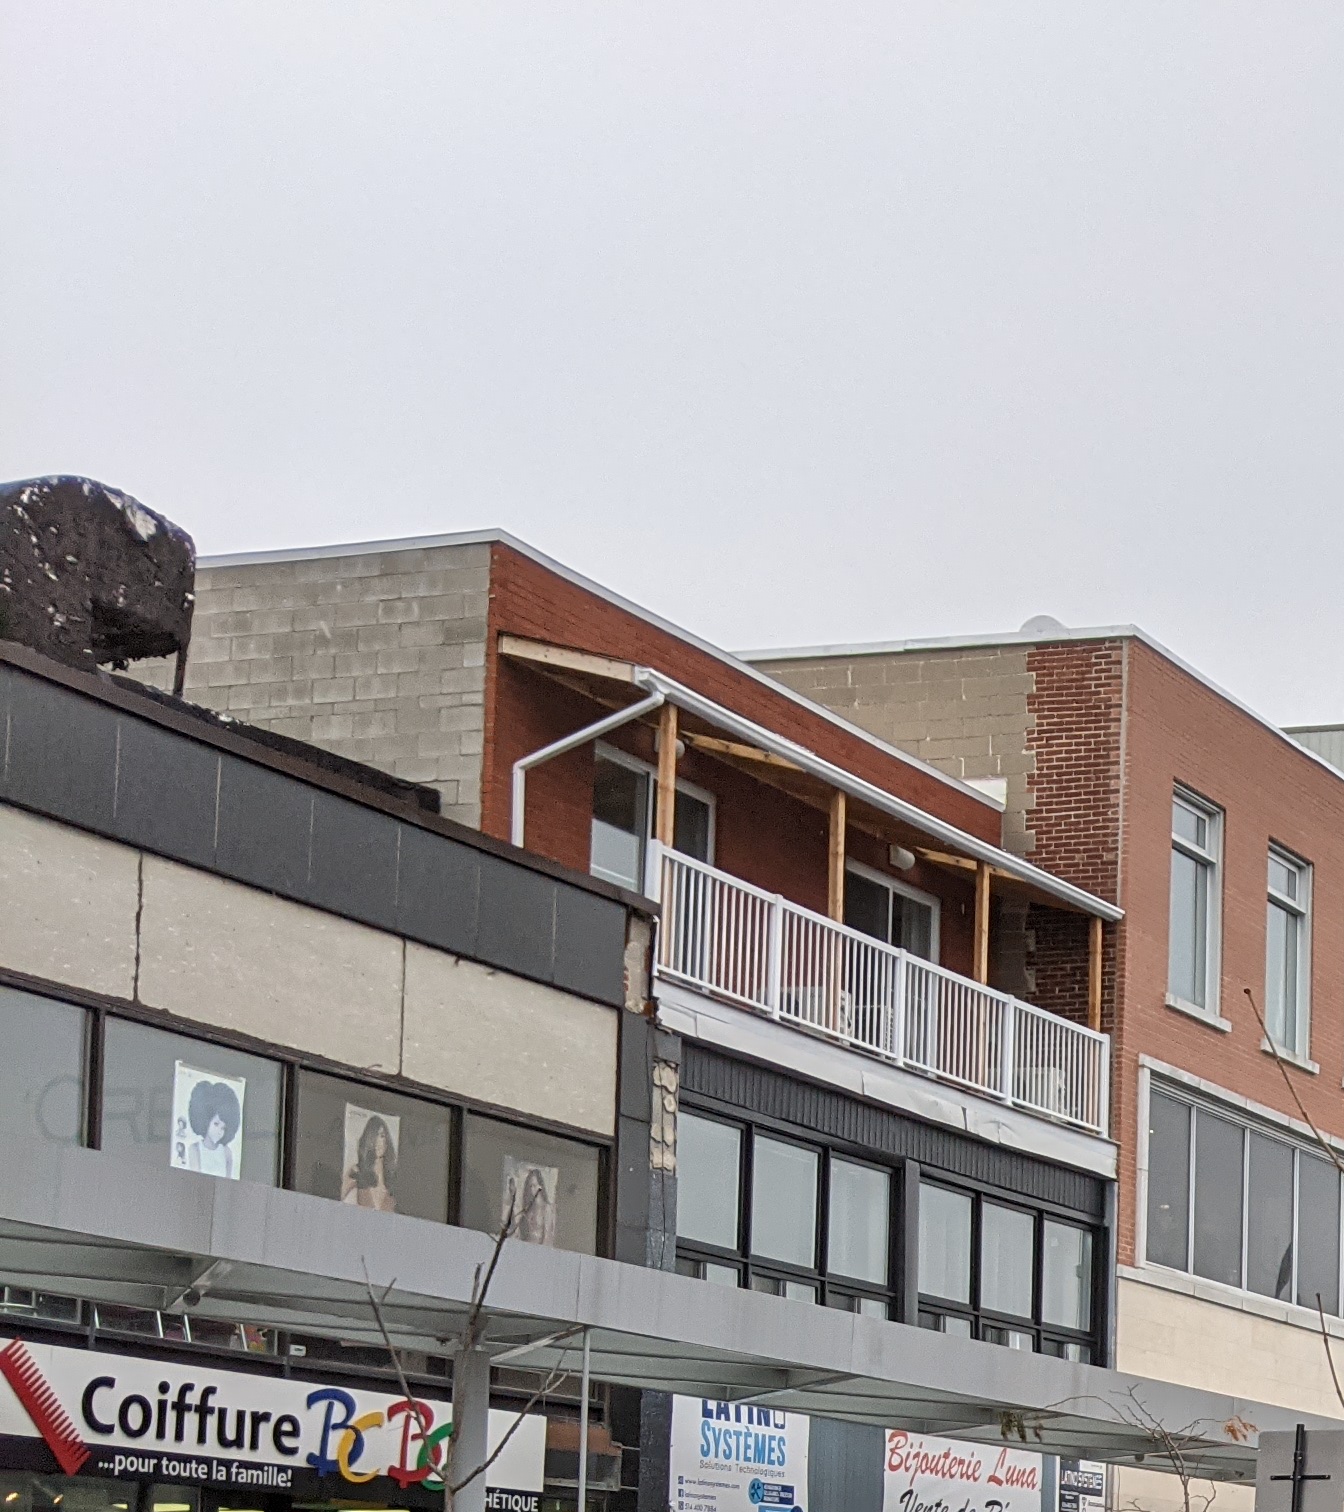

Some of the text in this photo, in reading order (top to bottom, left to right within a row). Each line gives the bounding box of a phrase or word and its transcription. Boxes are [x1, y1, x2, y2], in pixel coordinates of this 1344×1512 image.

[82, 1376, 301, 1455] Coiffure
[161, 1456, 208, 1480] toute
[211, 1459, 227, 1481] la
[230, 1462, 293, 1487] famille!
[888, 1430, 1038, 1490] Bijouterie Luna
